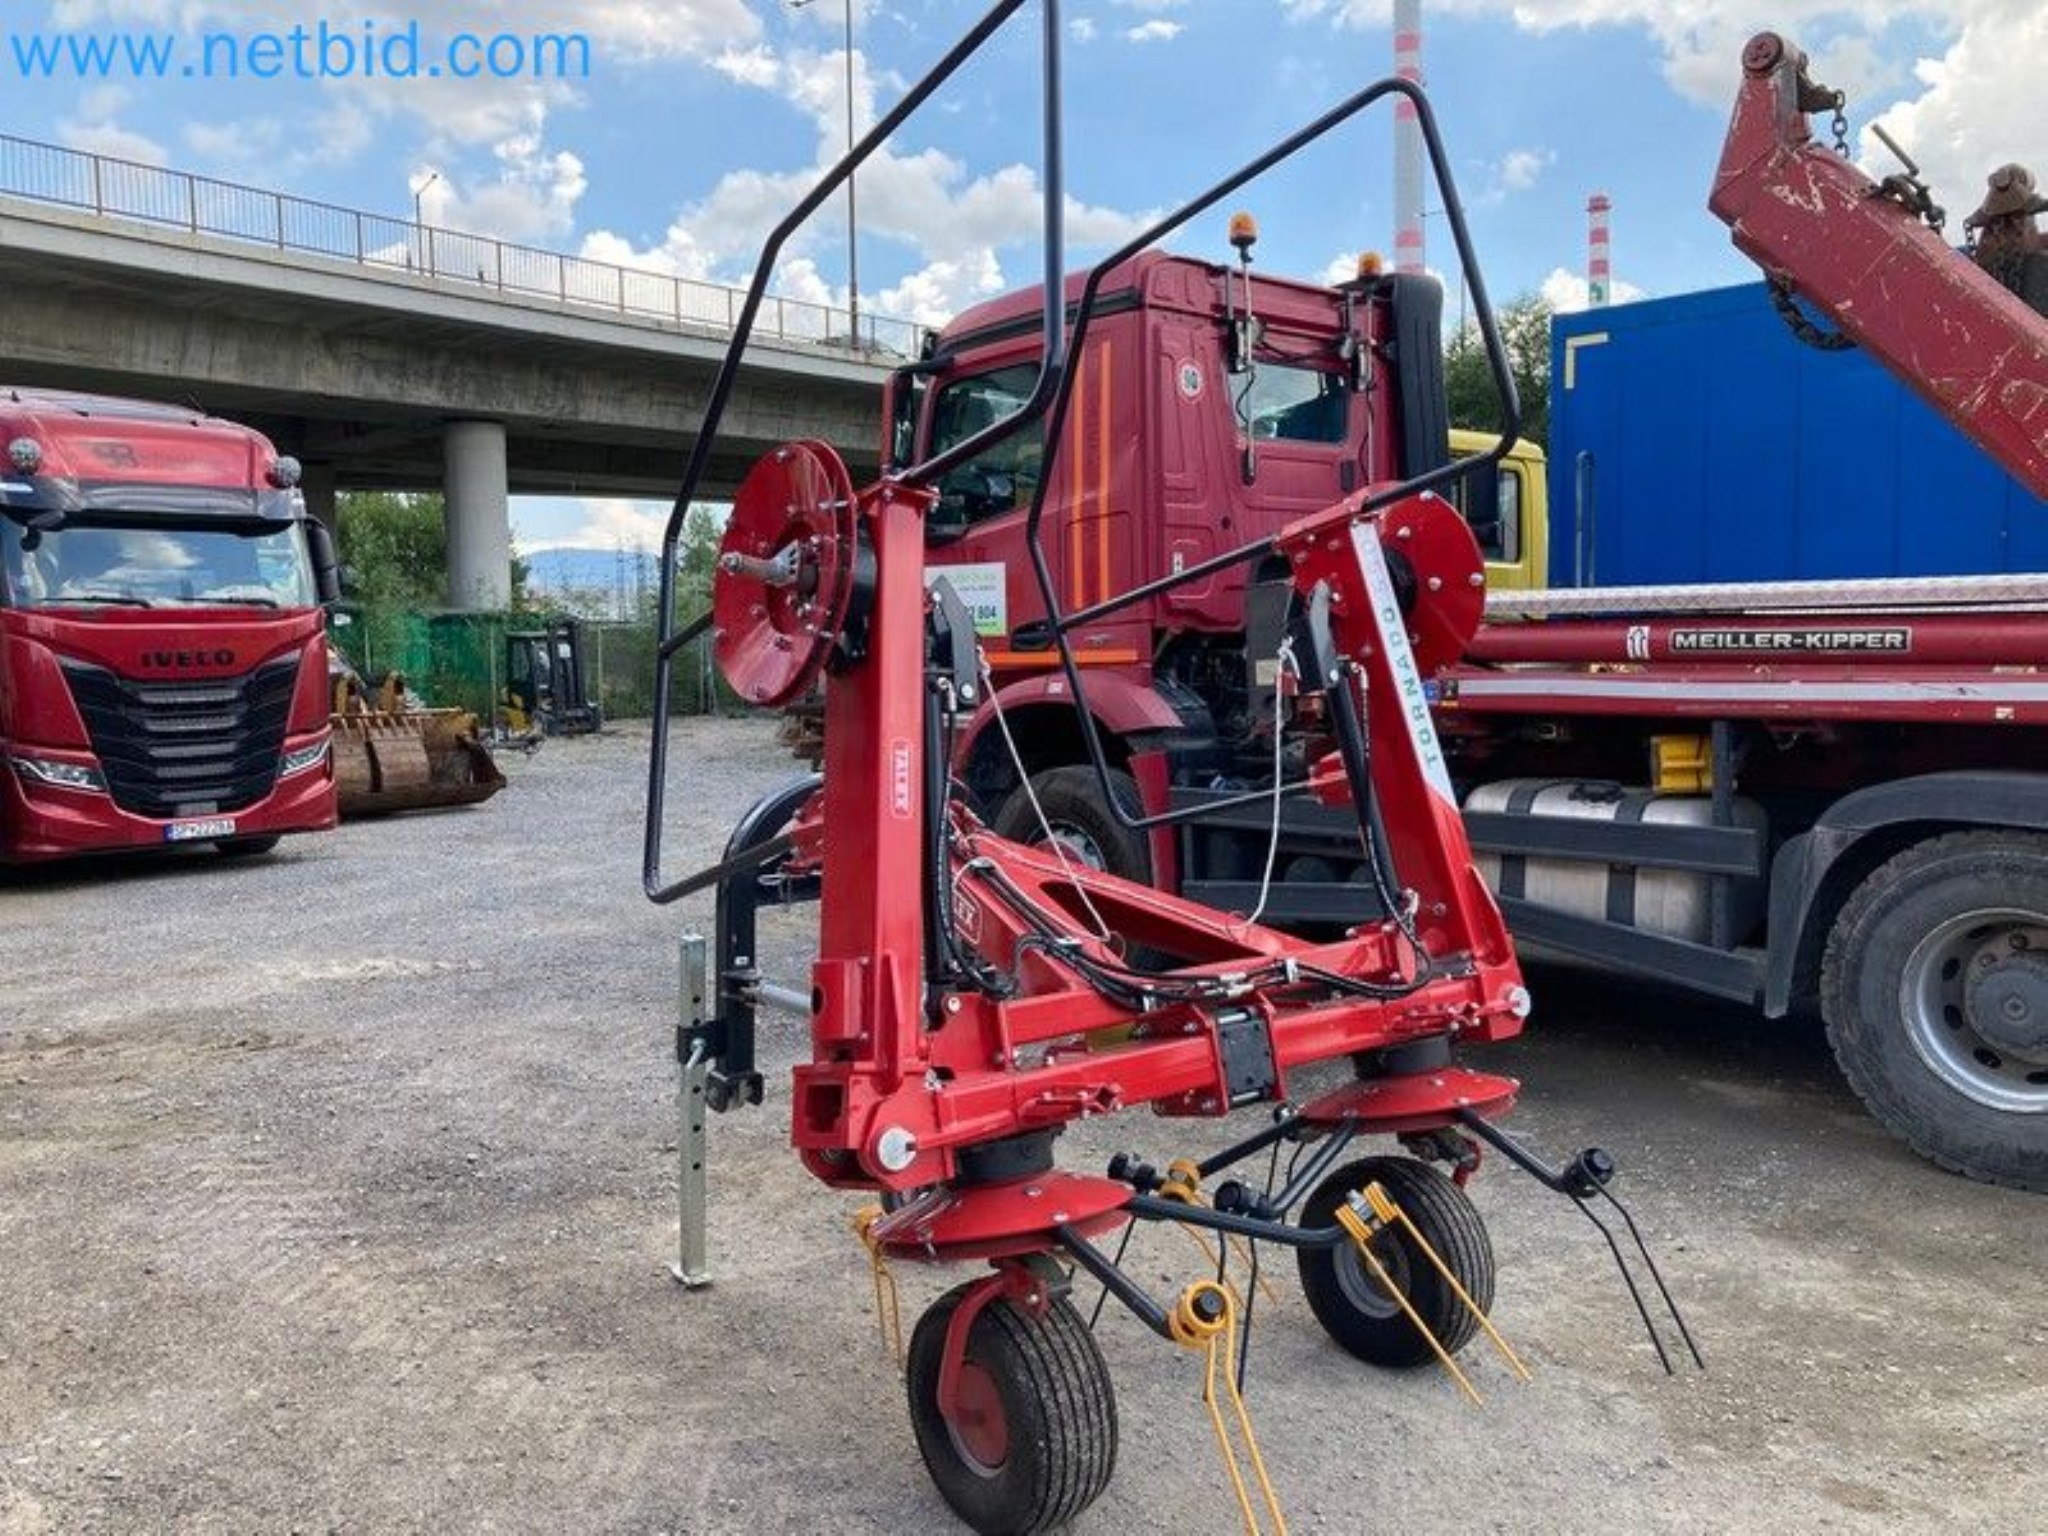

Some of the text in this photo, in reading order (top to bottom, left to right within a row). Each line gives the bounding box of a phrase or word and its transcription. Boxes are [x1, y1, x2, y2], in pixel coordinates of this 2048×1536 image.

[1674, 632, 1904, 649] MEILLER-KIPPER
[141, 649, 235, 668] IVECO
[1382, 606, 1438, 769] TORNADO
